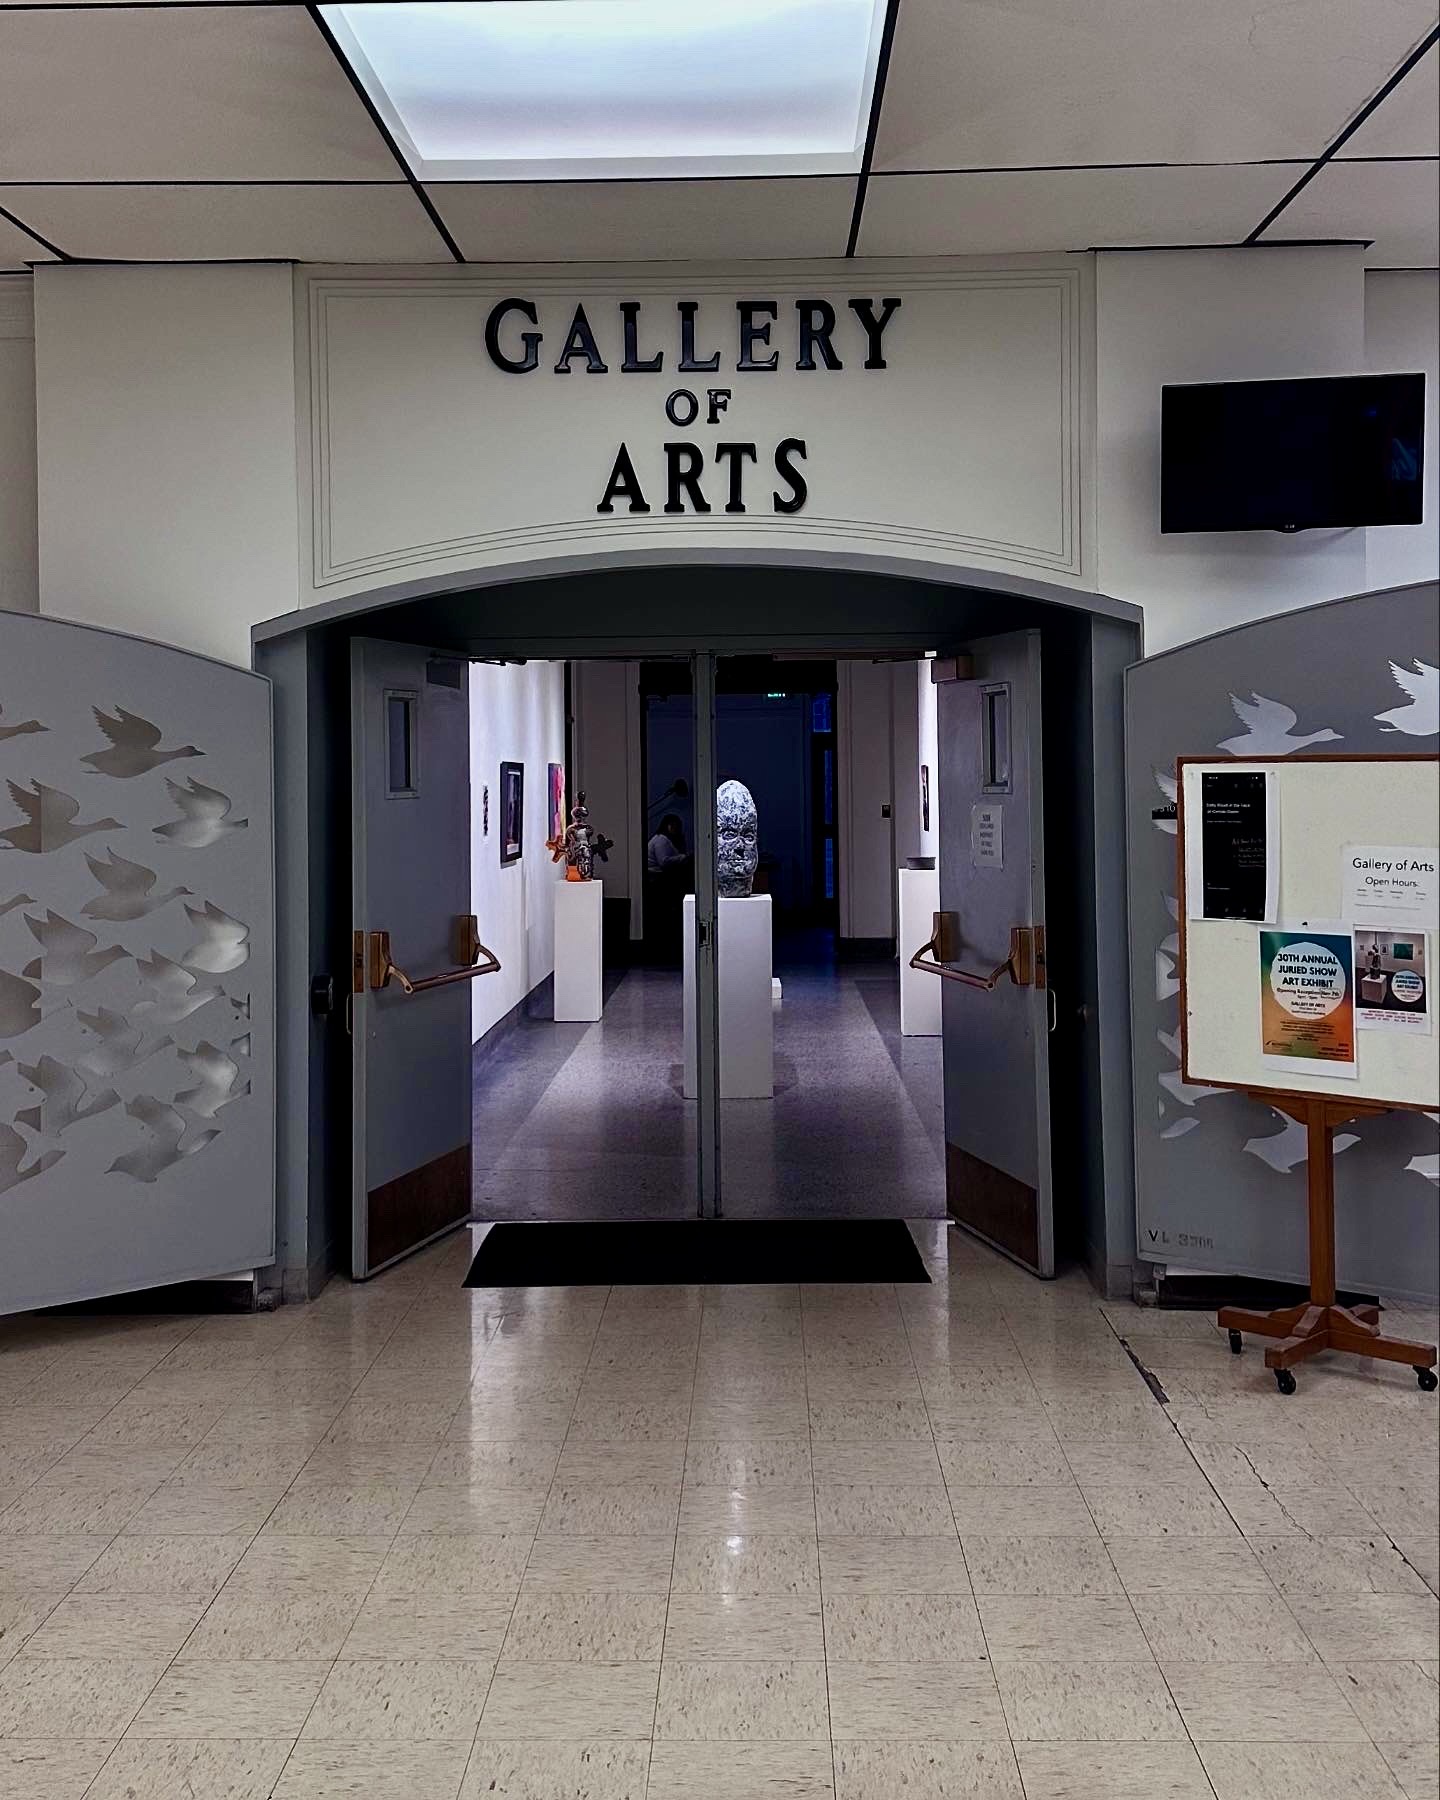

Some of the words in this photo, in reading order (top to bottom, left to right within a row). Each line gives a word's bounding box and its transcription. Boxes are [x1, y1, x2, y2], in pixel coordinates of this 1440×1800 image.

[485, 297, 901, 374] GALLERY
[665, 388, 731, 427] OF
[597, 437, 808, 514] ARTS
[1352, 857, 1393, 873] Gallery
[1395, 859, 1408, 871] of
[1410, 860, 1435, 872] Arts
[1365, 876, 1390, 887] Open
[1277, 953, 1300, 963] 30TH
[1301, 954, 1338, 965] ANNUAL
[1278, 965, 1308, 975] JURIED
[1310, 966, 1338, 977] SHOW
[1282, 976, 1299, 986] ART
[1301, 978, 1334, 988] EXHIBIT
